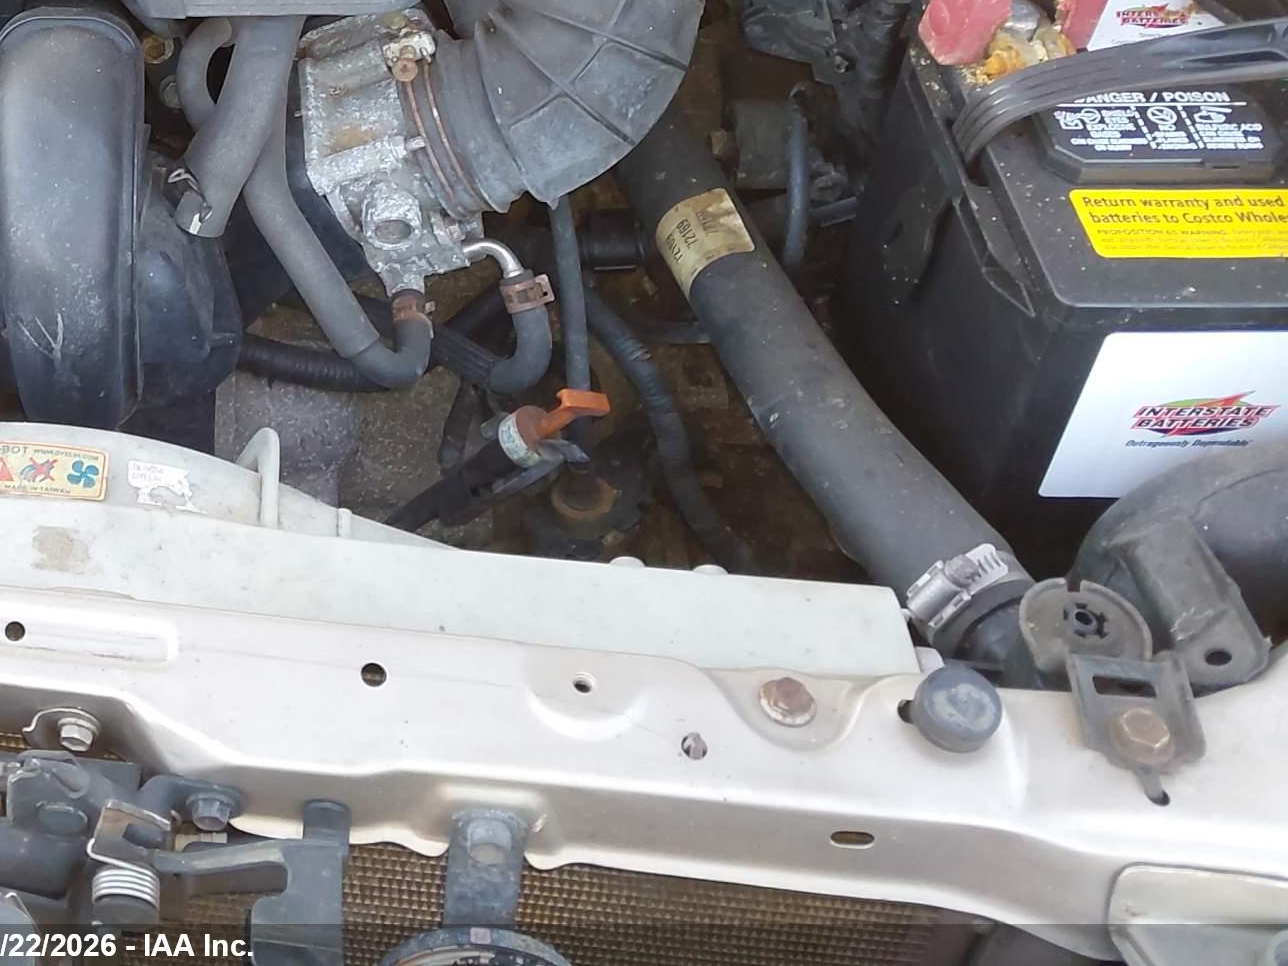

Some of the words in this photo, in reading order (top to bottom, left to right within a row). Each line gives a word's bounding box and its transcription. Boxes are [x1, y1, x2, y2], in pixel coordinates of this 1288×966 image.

[1074, 91, 1147, 103] ANGER
[1162, 91, 1231, 102] POISON
[1082, 196, 1136, 208] Return
[1139, 197, 1210, 210] warranty
[1214, 196, 1244, 207] and
[1247, 196, 1284, 207] used
[1089, 212, 1161, 224] batteries
[1163, 213, 1179, 224] to
[1182, 212, 1233, 224] Costco
[1234, 211, 1288, 223] Whole
[1137, 406, 1269, 417] INTERSTATE
[1136, 418, 1256, 428] BATTERIES
